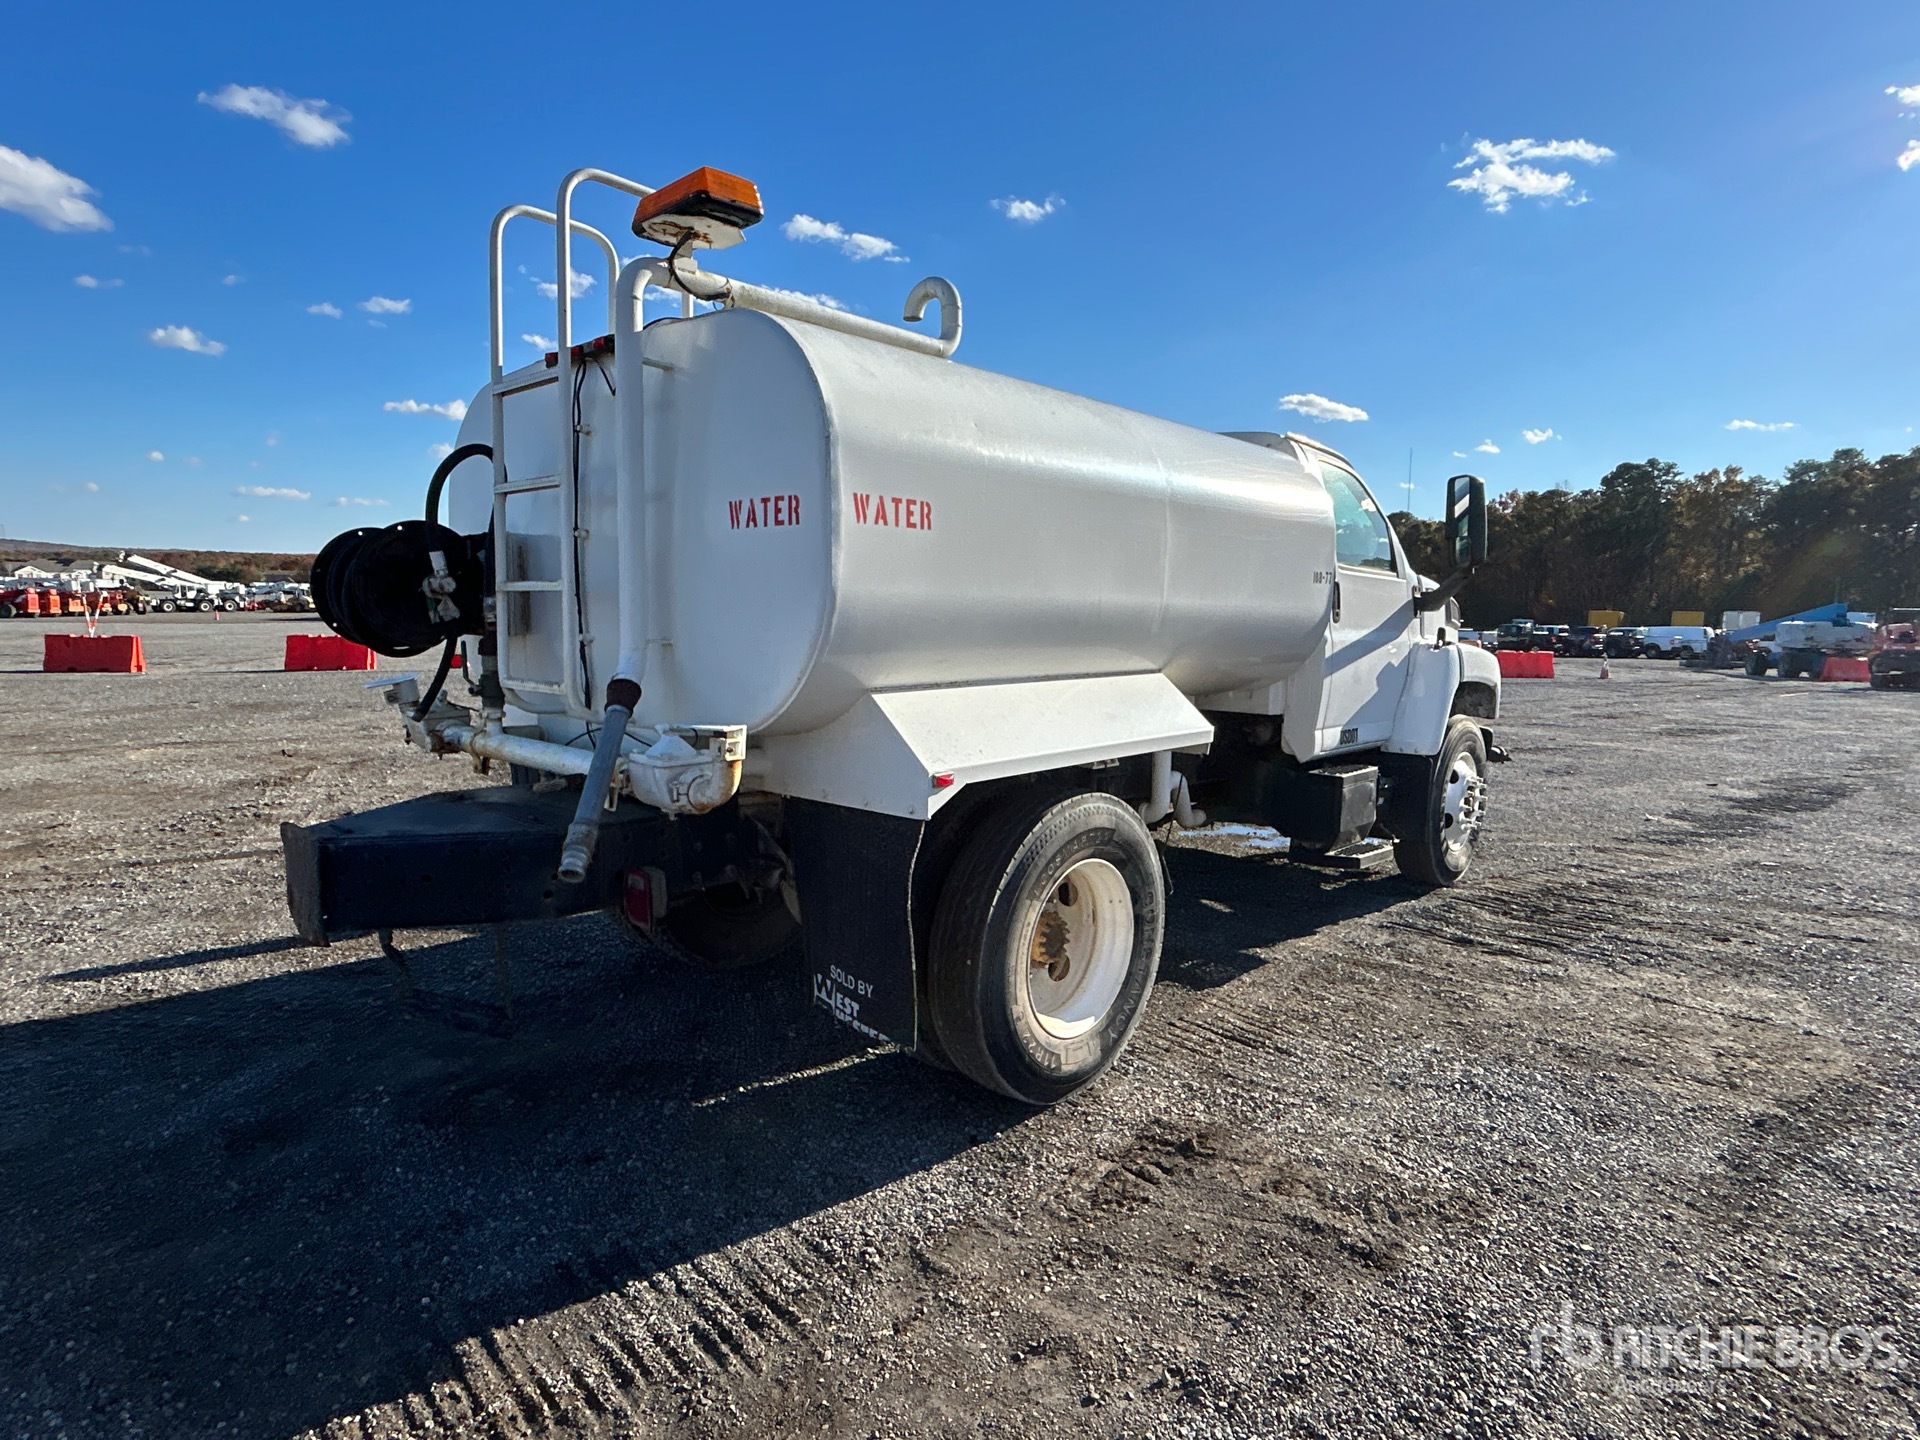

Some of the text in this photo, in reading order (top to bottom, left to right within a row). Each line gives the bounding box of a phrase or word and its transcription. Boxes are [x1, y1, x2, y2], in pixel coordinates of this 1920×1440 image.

[728, 495, 800, 529] WATER
[853, 493, 932, 530] WATER
[1340, 728, 1358, 745] USDOT
[830, 964, 873, 998] SOLD BY
